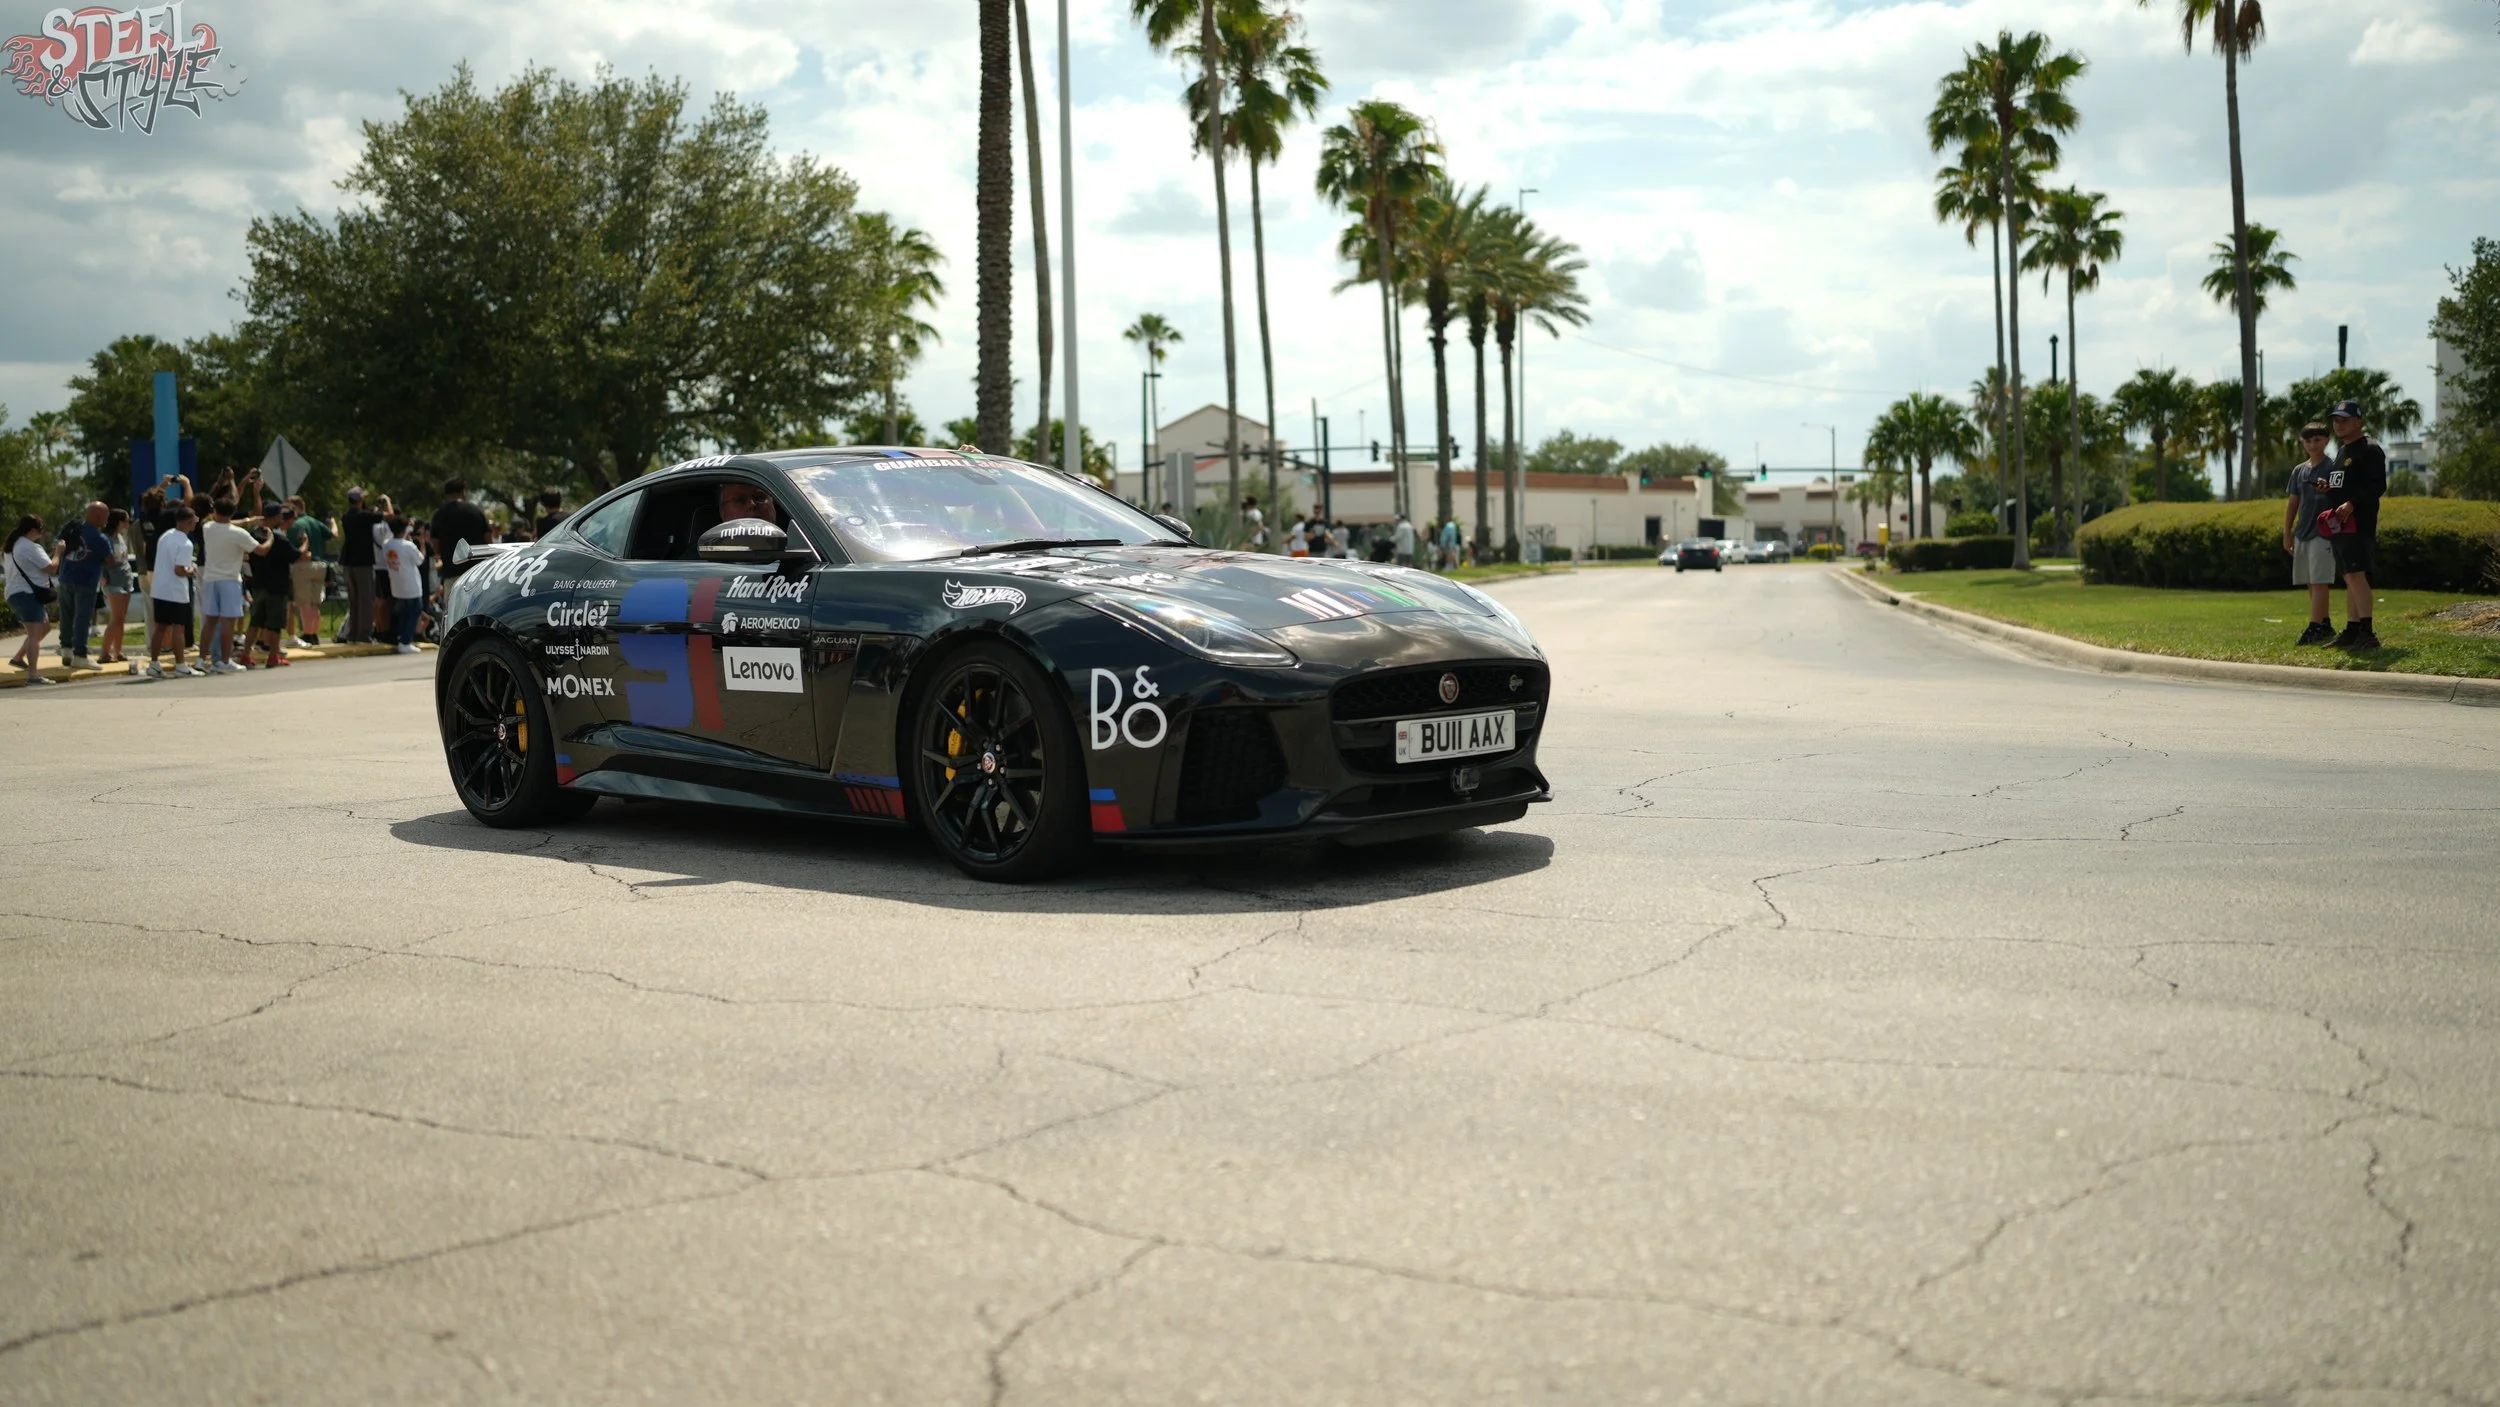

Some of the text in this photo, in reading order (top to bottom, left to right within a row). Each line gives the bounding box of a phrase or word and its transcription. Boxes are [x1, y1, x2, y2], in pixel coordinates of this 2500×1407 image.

[872, 459, 975, 472] GUMBALL
[720, 525, 773, 540] mph club
[552, 580, 576, 590] BANG
[582, 579, 618, 589] OLUFSEN
[726, 575, 809, 604] Hard Rock
[740, 617, 800, 630] AEROMEXICO
[813, 636, 858, 645] JAGUAR
[545, 645, 610, 656] ULYSSE NARDIN
[729, 656, 795, 681] Lenovo
[547, 674, 615, 699] MONEX
[1469, 715, 1505, 749] AAX
